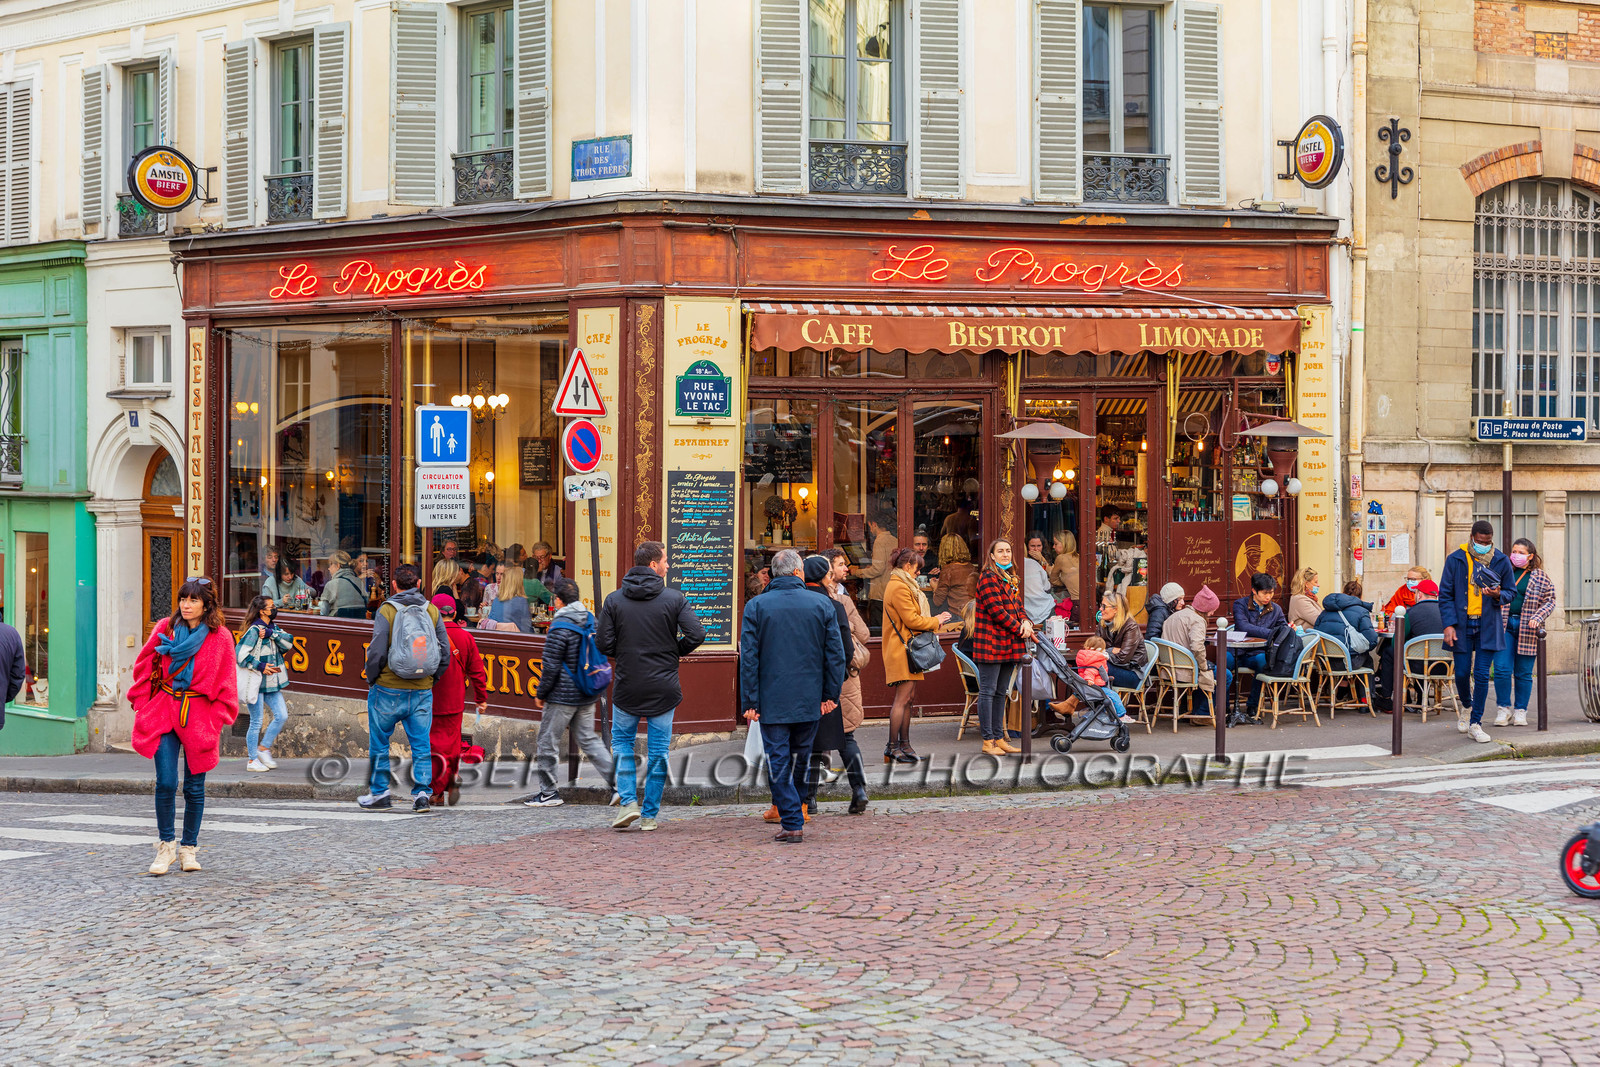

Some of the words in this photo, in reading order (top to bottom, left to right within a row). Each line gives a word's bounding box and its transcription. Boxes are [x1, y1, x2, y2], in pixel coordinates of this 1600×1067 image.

[594, 145, 610, 154] RUE
[594, 156, 609, 165] DES
[150, 168, 186, 181] AMSTEL
[576, 168, 597, 177] TROIS
[598, 164, 628, 175] FRÈRES
[156, 181, 181, 190] BIERE
[872, 244, 949, 282] Le
[975, 247, 1185, 292] Progrès
[269, 263, 318, 299] Le
[332, 259, 488, 294] Progrès
[696, 323, 710, 331] LE
[801, 318, 874, 346] CAFE
[948, 321, 1066, 348] BISTROT
[1138, 323, 1265, 348] LIMONADE
[1302, 341, 1326, 350] PLAT
[1303, 362, 1324, 370] JOUR
[694, 382, 714, 391] RUE
[683, 392, 725, 401] YVONNE
[686, 402, 699, 410] LE
[702, 402, 721, 410] TAC
[131, 412, 136, 426] 7
[1503, 421, 1529, 430] Bureau
[1531, 421, 1541, 430] de
[1542, 421, 1563, 430] Poste
[1542, 431, 1570, 439] Abbesses
[674, 439, 729, 447] ESTAMINET
[192, 342, 203, 571] RESTAURANT
[1303, 461, 1327, 470] GRILL
